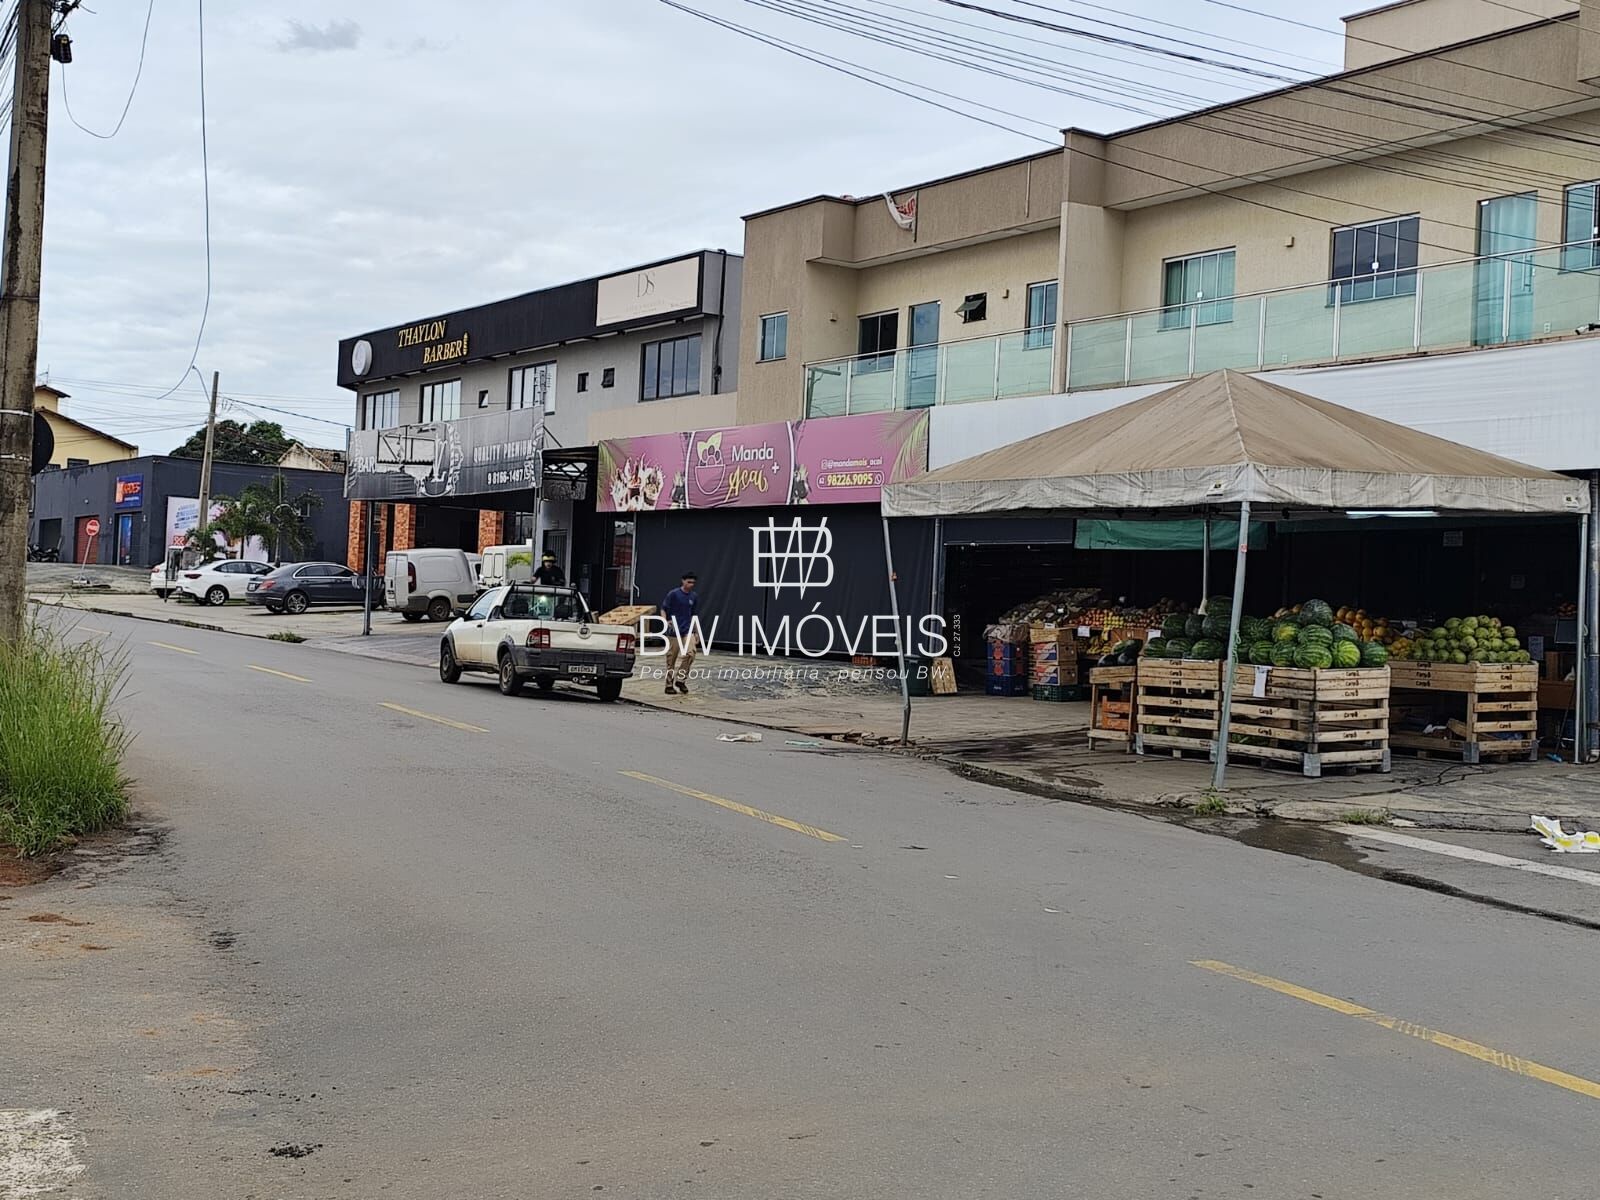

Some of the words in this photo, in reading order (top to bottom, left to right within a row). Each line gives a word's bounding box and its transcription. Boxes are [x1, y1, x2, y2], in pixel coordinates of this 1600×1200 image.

[398, 319, 447, 348] THAYLON
[423, 340, 463, 364] BARBER
[473, 443, 500, 463] QUALITY
[503, 439, 532, 459] PREMIUM
[731, 441, 774, 461] Manda
[827, 473, 873, 486] 98226.9095
